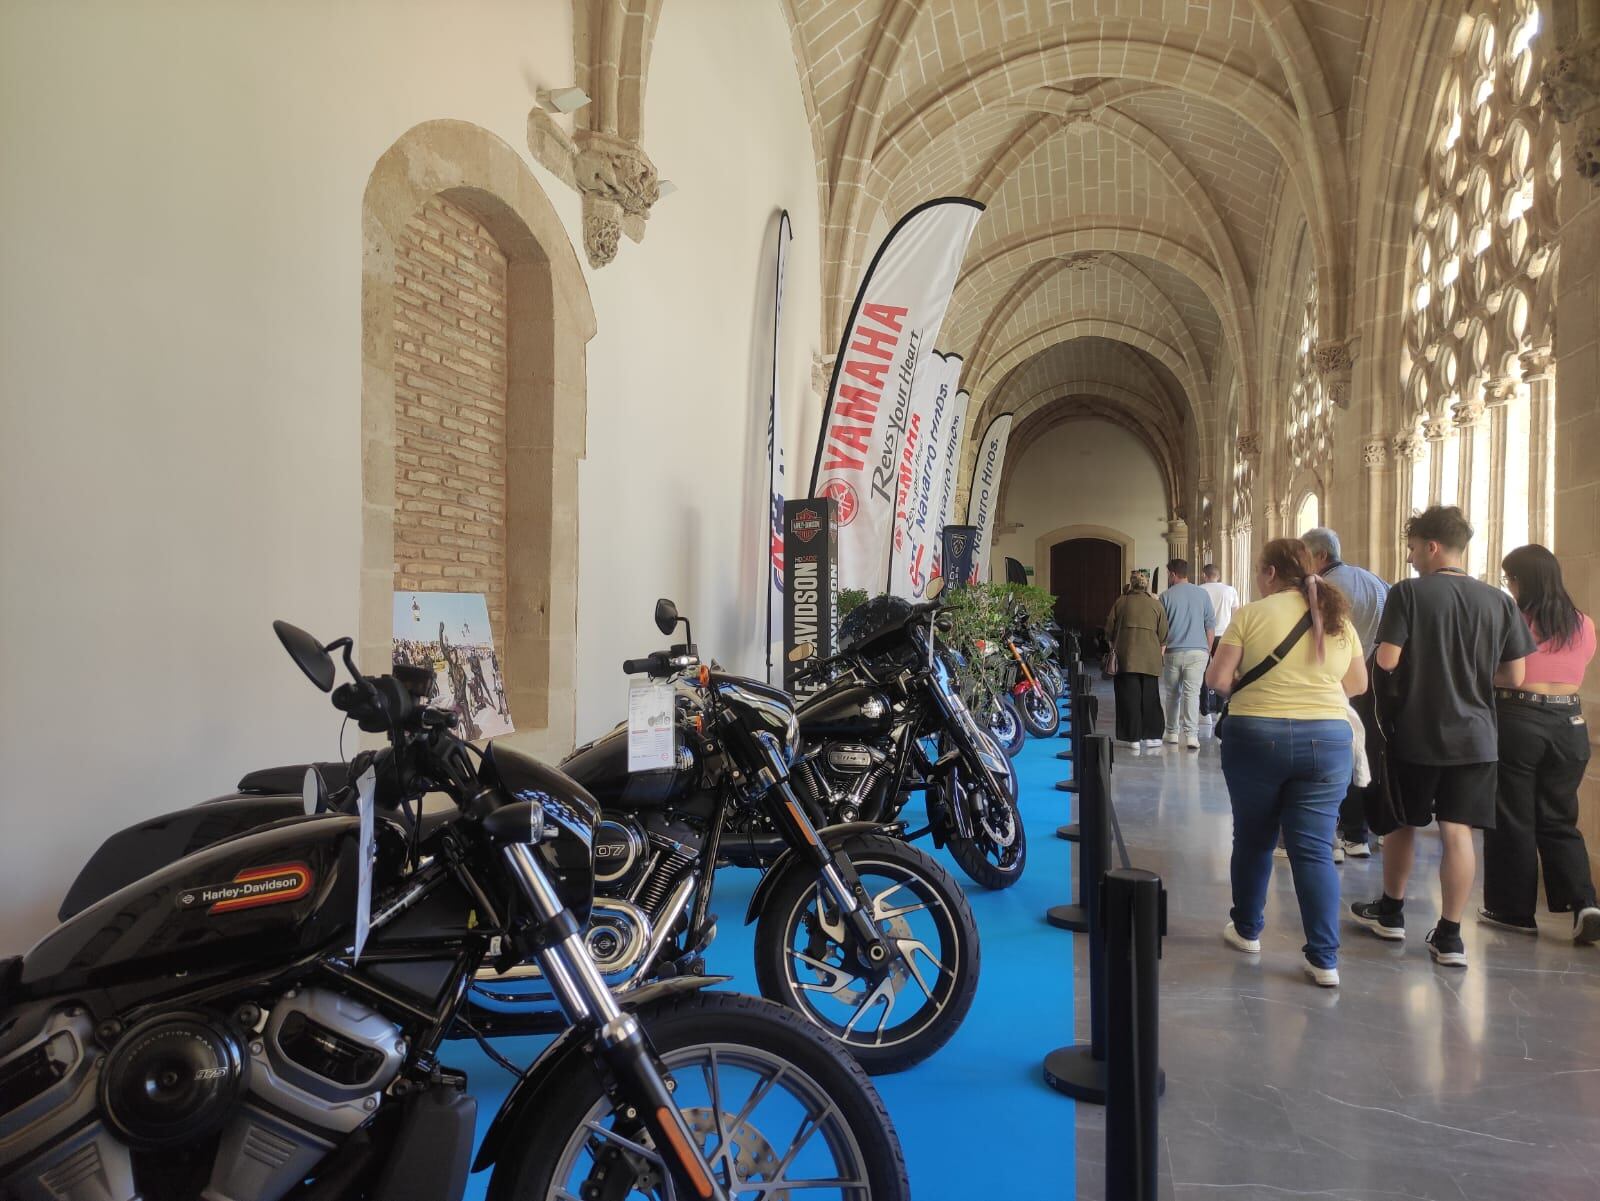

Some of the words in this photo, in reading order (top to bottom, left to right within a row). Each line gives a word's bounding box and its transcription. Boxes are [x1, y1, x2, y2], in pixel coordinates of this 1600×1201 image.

[823, 302, 909, 472] YAMAHA
[871, 430, 894, 504] Revs
[887, 382, 908, 434] Your
[898, 328, 920, 386] Heart
[915, 444, 937, 534] Navarro
[972, 488, 990, 556] Navarro
[981, 437, 999, 487] Hnos.
[202, 877, 298, 902] Harley-Davidson
